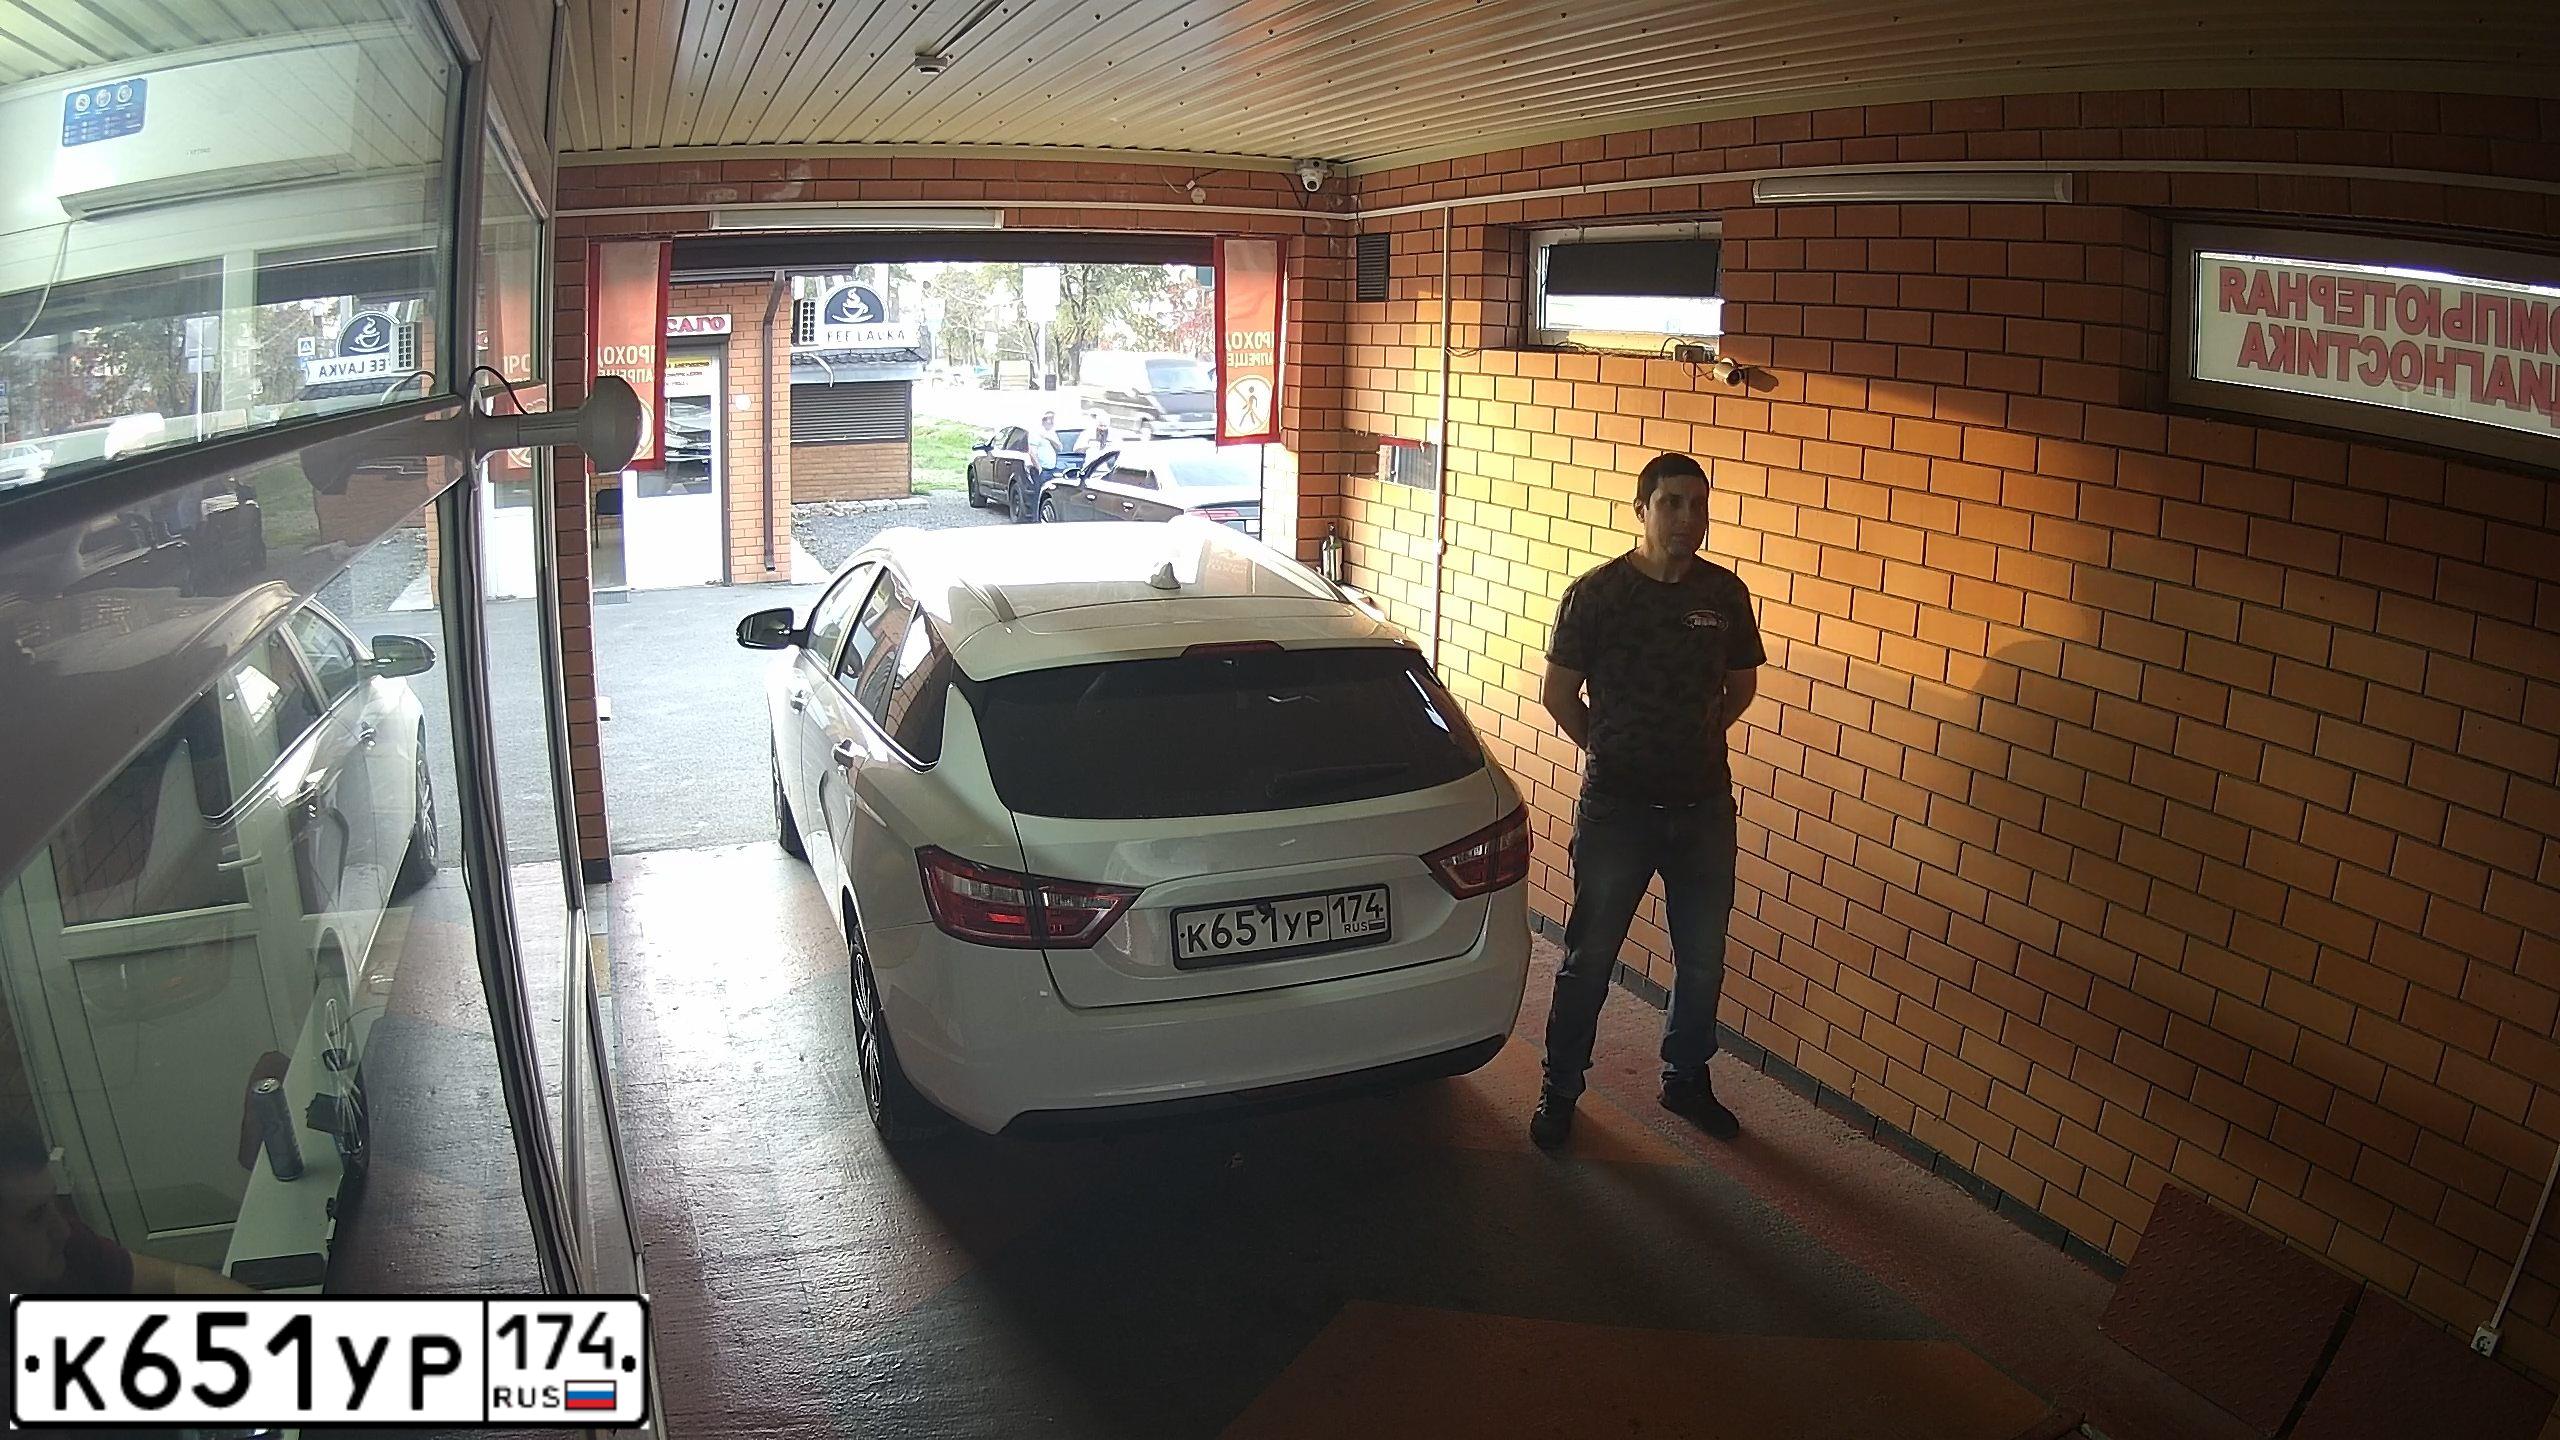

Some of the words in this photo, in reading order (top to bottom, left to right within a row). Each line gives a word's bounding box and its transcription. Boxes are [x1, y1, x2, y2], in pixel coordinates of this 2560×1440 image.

[1187, 905, 1324, 953] К651УР
[1332, 893, 1381, 924] 174
[1344, 923, 1368, 933] RUS
